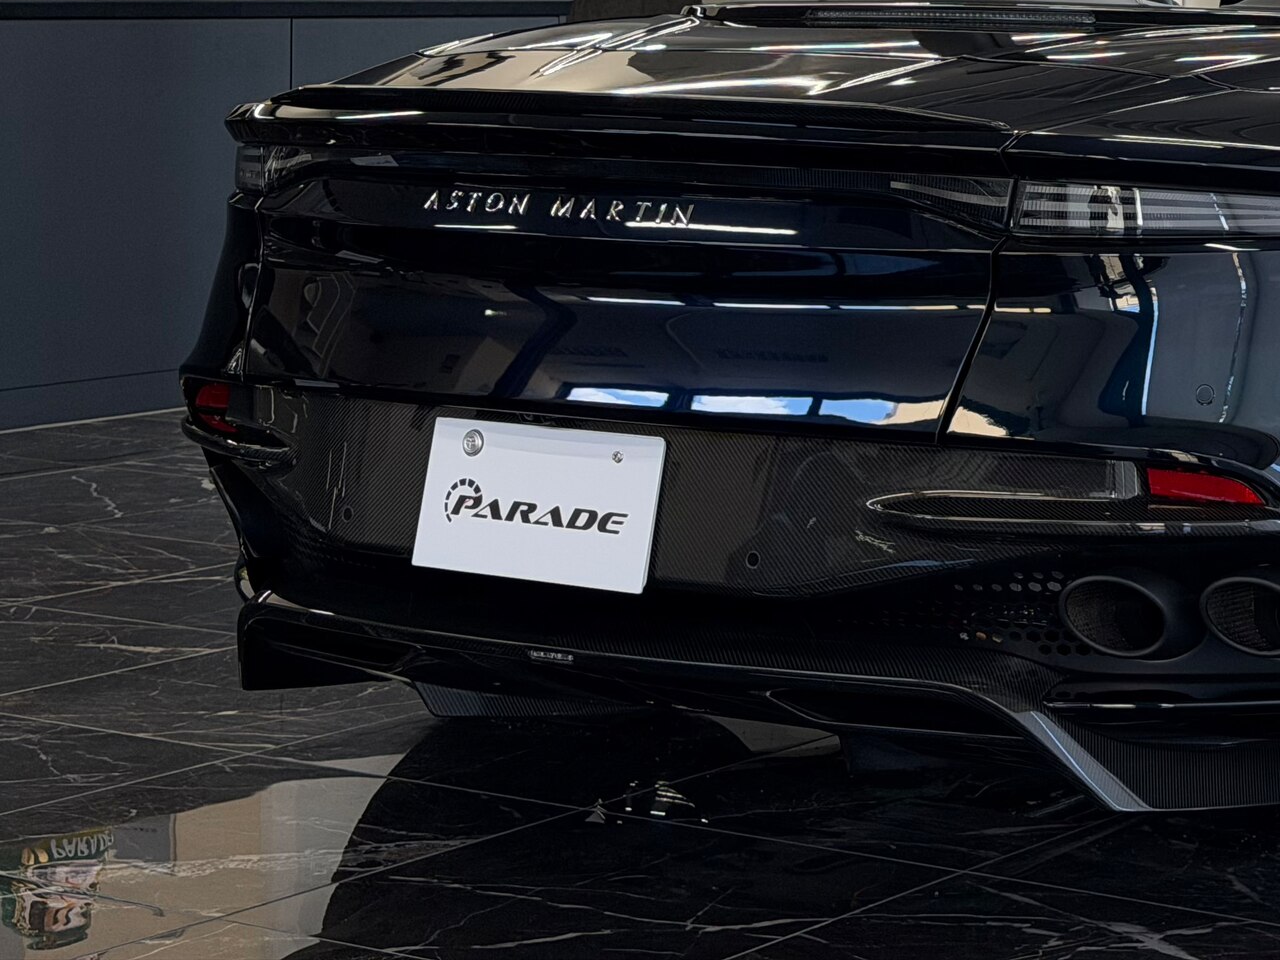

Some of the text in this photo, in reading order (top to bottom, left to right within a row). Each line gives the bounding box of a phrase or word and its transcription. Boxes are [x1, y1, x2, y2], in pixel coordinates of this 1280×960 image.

[423, 190, 694, 225] ASTON MARTIN
[447, 489, 629, 535] PARADE
